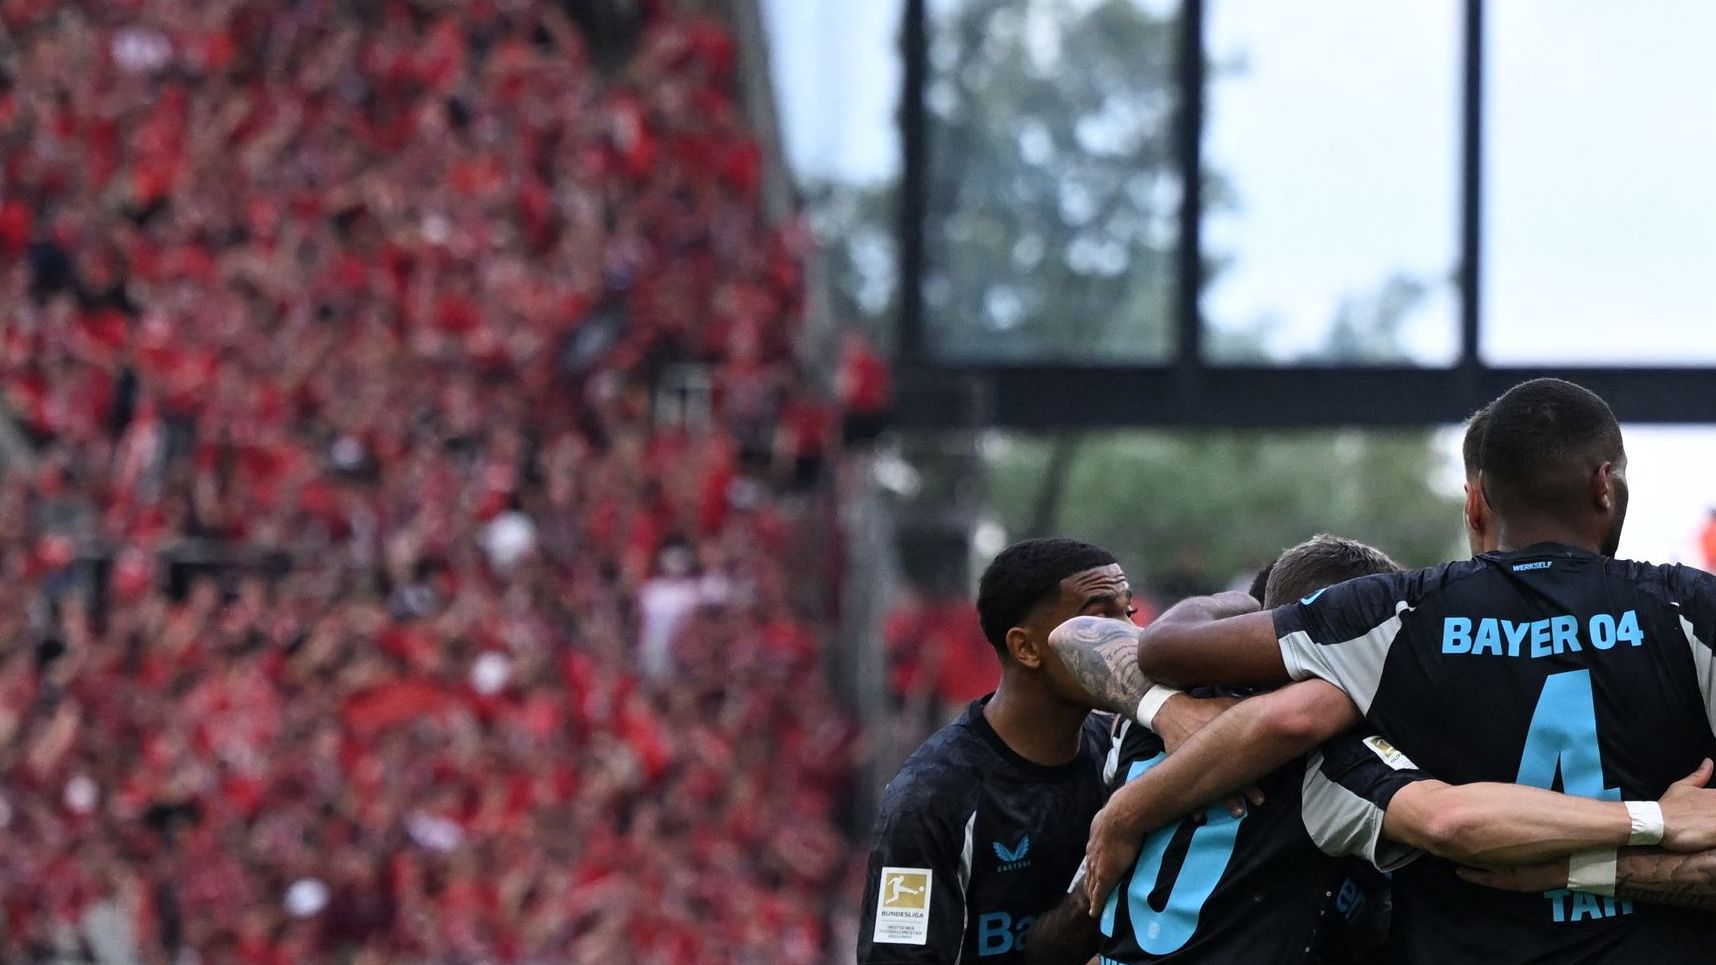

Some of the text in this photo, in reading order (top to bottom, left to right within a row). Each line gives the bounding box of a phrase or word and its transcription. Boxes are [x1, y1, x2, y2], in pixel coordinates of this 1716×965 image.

[1512, 561, 1553, 572] WERKSELF
[1441, 609, 1645, 659] BAYER 04
[1515, 668, 1622, 802] 4
[881, 911, 924, 919] BUNDESLIGA
